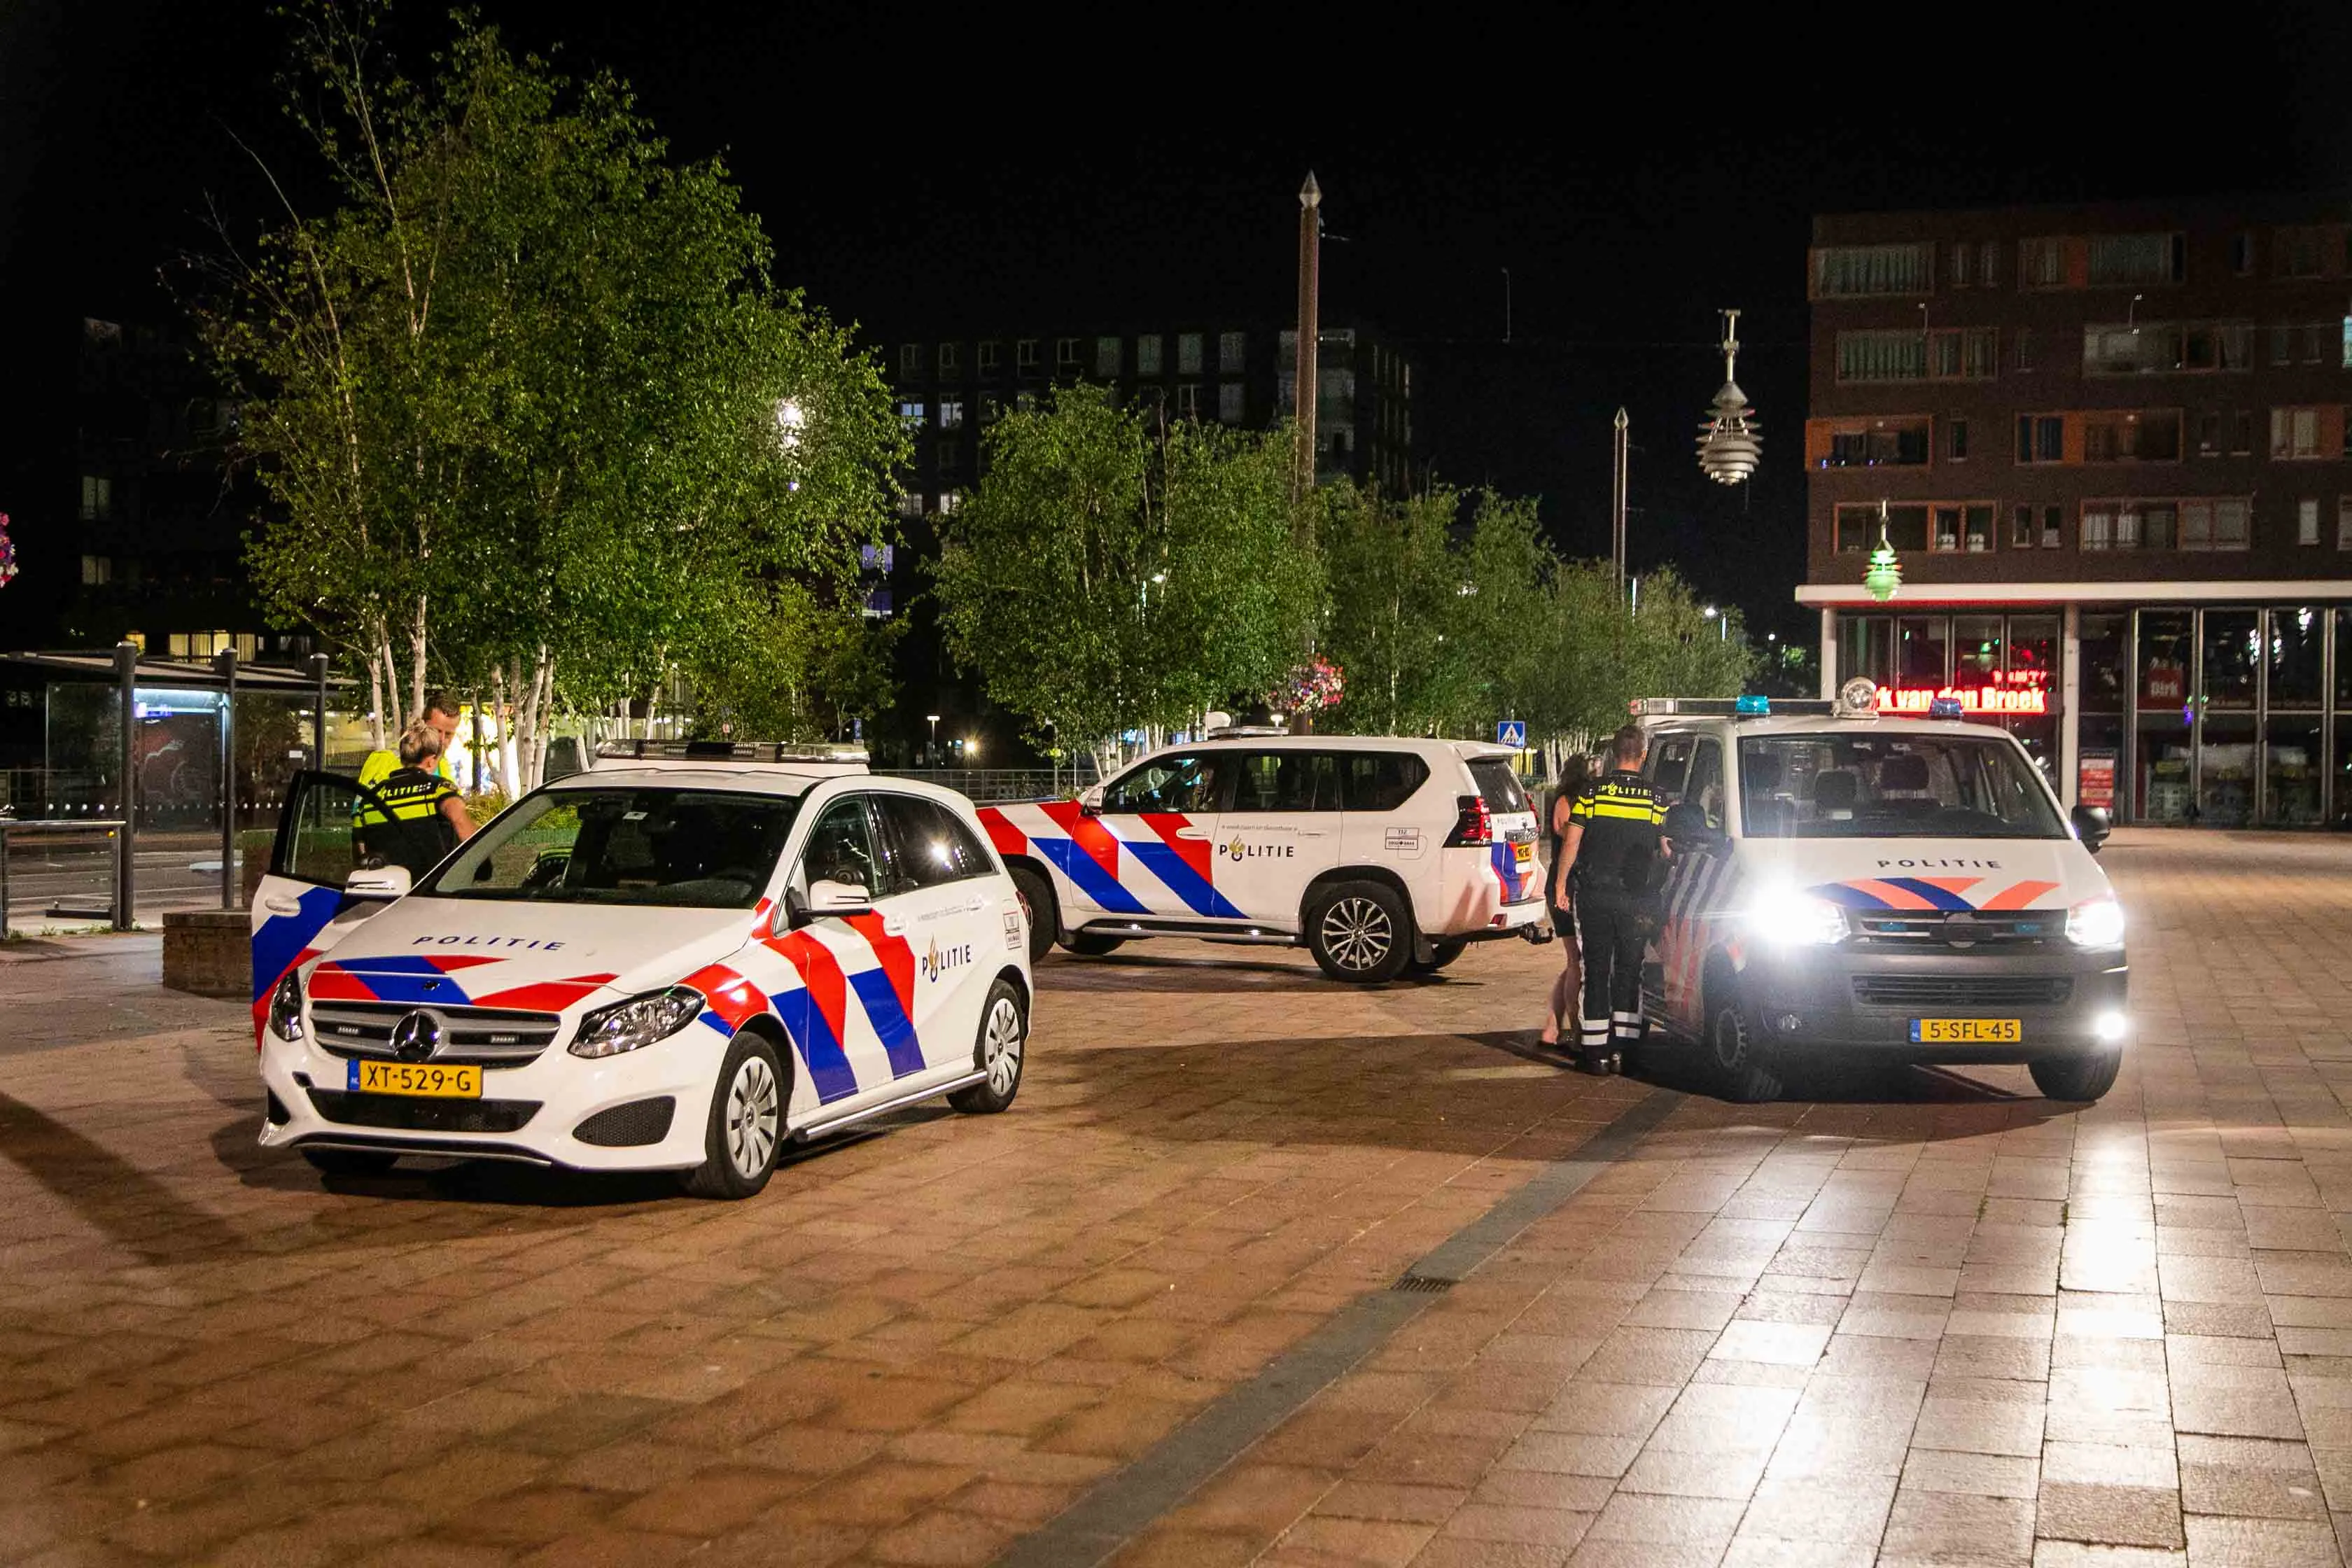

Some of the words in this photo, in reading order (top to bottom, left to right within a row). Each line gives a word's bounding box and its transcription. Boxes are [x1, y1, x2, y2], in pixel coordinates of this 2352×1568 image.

[1896, 690, 1934, 707] van
[1982, 687, 2045, 708] Broek
[1601, 783, 1648, 796] POLITIE
[1219, 843, 1294, 862] POLITIE
[1877, 859, 2002, 869] POLITIE
[412, 935, 566, 951] POLITIE
[922, 944, 972, 983] POLITIE
[1930, 1021, 2015, 1039] 5-SFL-45
[367, 1065, 471, 1092] XT-529-G
